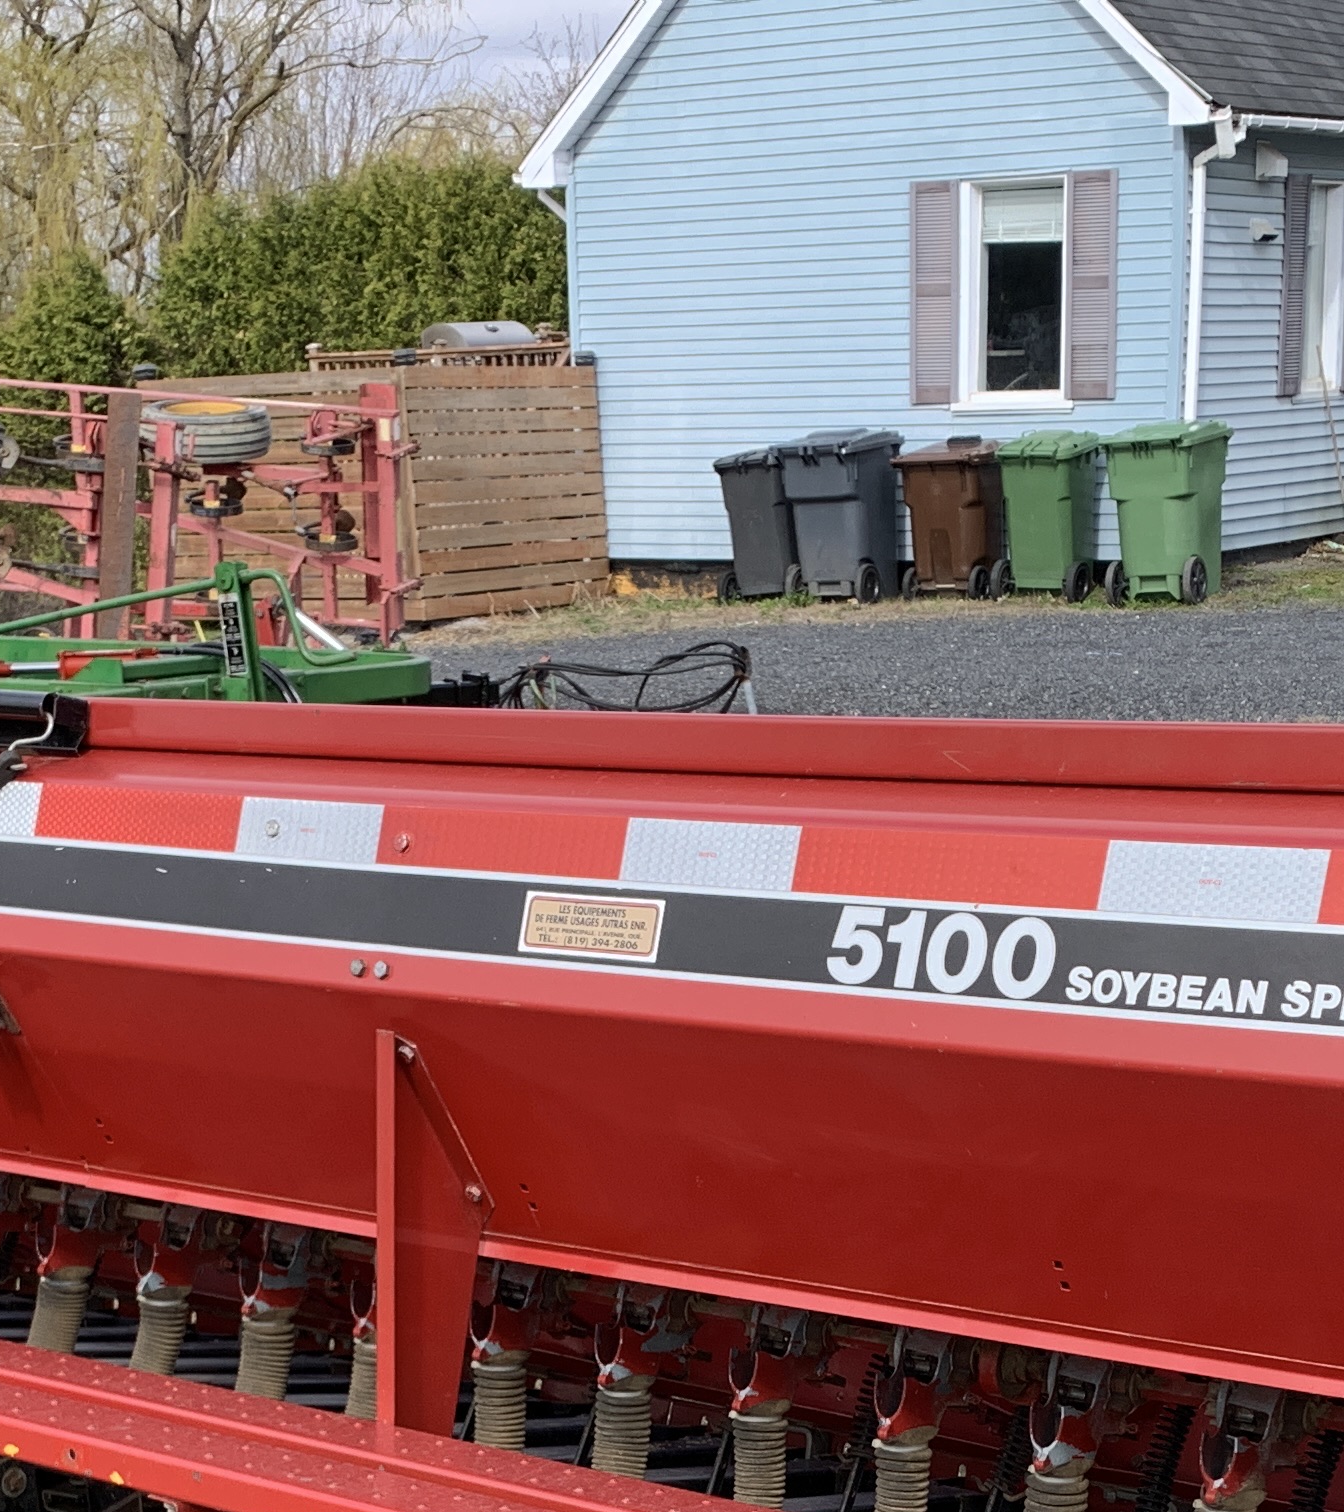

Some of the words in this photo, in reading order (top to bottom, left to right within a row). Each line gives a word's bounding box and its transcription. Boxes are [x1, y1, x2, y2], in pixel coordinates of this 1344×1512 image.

[559, 904, 571, 915] LES
[534, 913, 544, 923] DE
[545, 915, 569, 926] FERME
[601, 919, 629, 930] JUTRAS
[563, 935, 589, 948] (819)
[591, 938, 638, 950] 394-2806
[826, 905, 1056, 1000] 5100
[1065, 965, 1269, 1016] SOYBEAN
